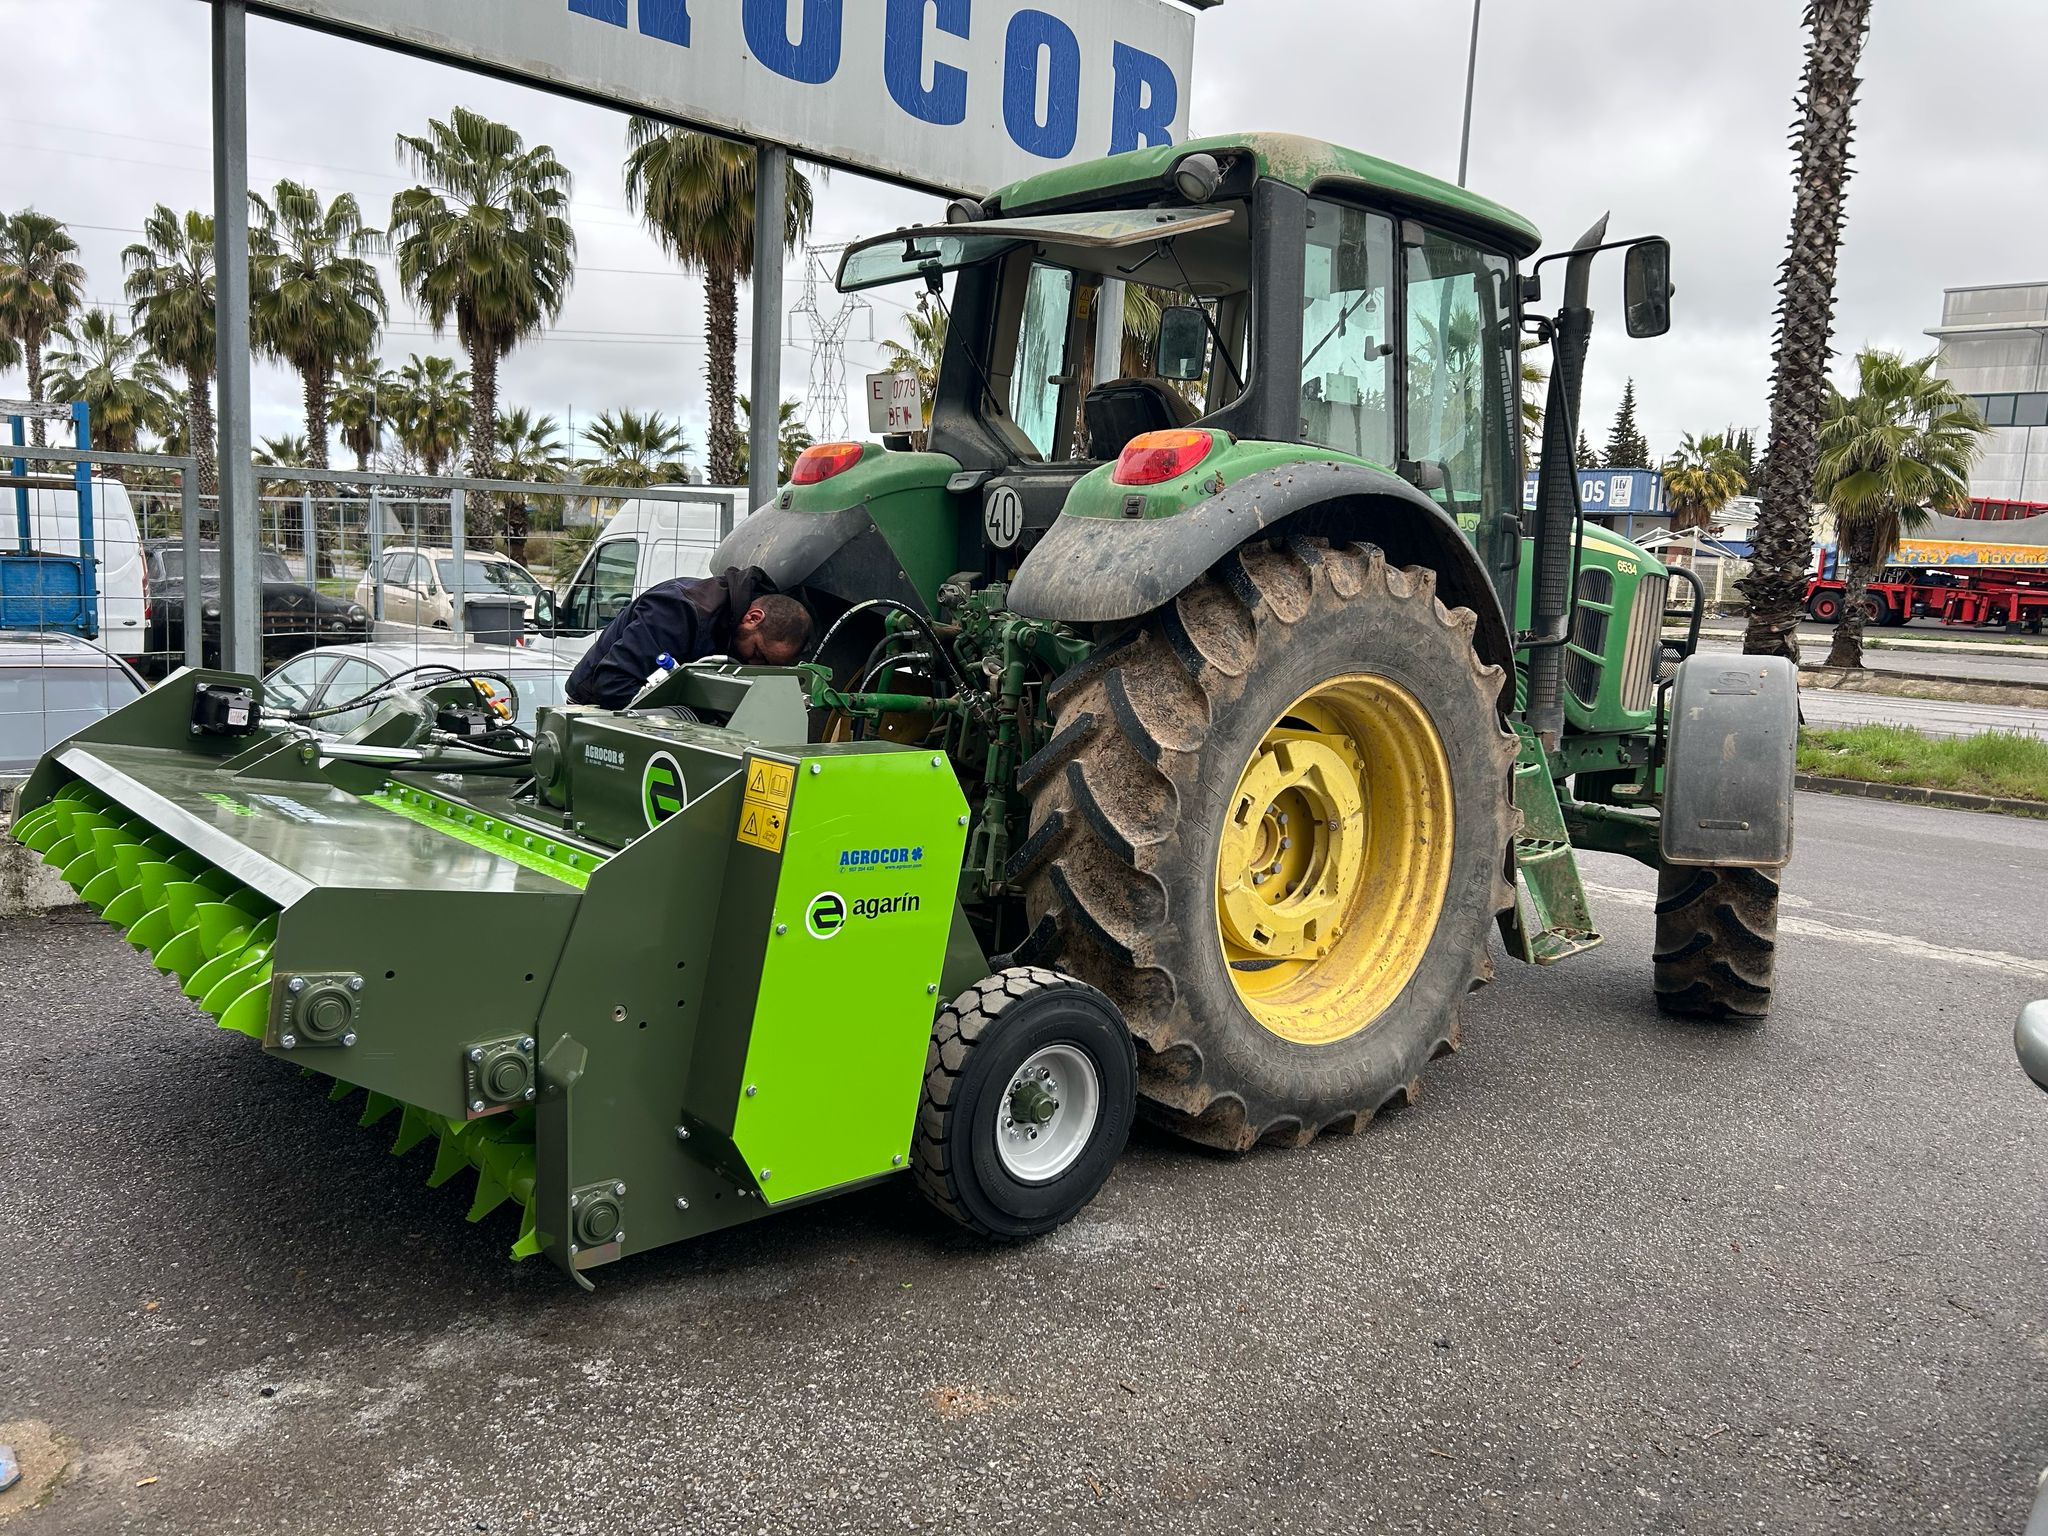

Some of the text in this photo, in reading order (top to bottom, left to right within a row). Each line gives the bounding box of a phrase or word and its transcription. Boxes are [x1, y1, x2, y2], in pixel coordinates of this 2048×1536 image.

[873, 378, 916, 400] E 0779
[888, 406, 910, 426] BFW
[988, 492, 1016, 541] 40
[1895, 547, 1950, 565] Crazy
[1617, 559, 1638, 576] 6534
[585, 744, 618, 764] AGROCOR
[839, 848, 909, 866] AGROCOR
[852, 892, 920, 919] agarín
